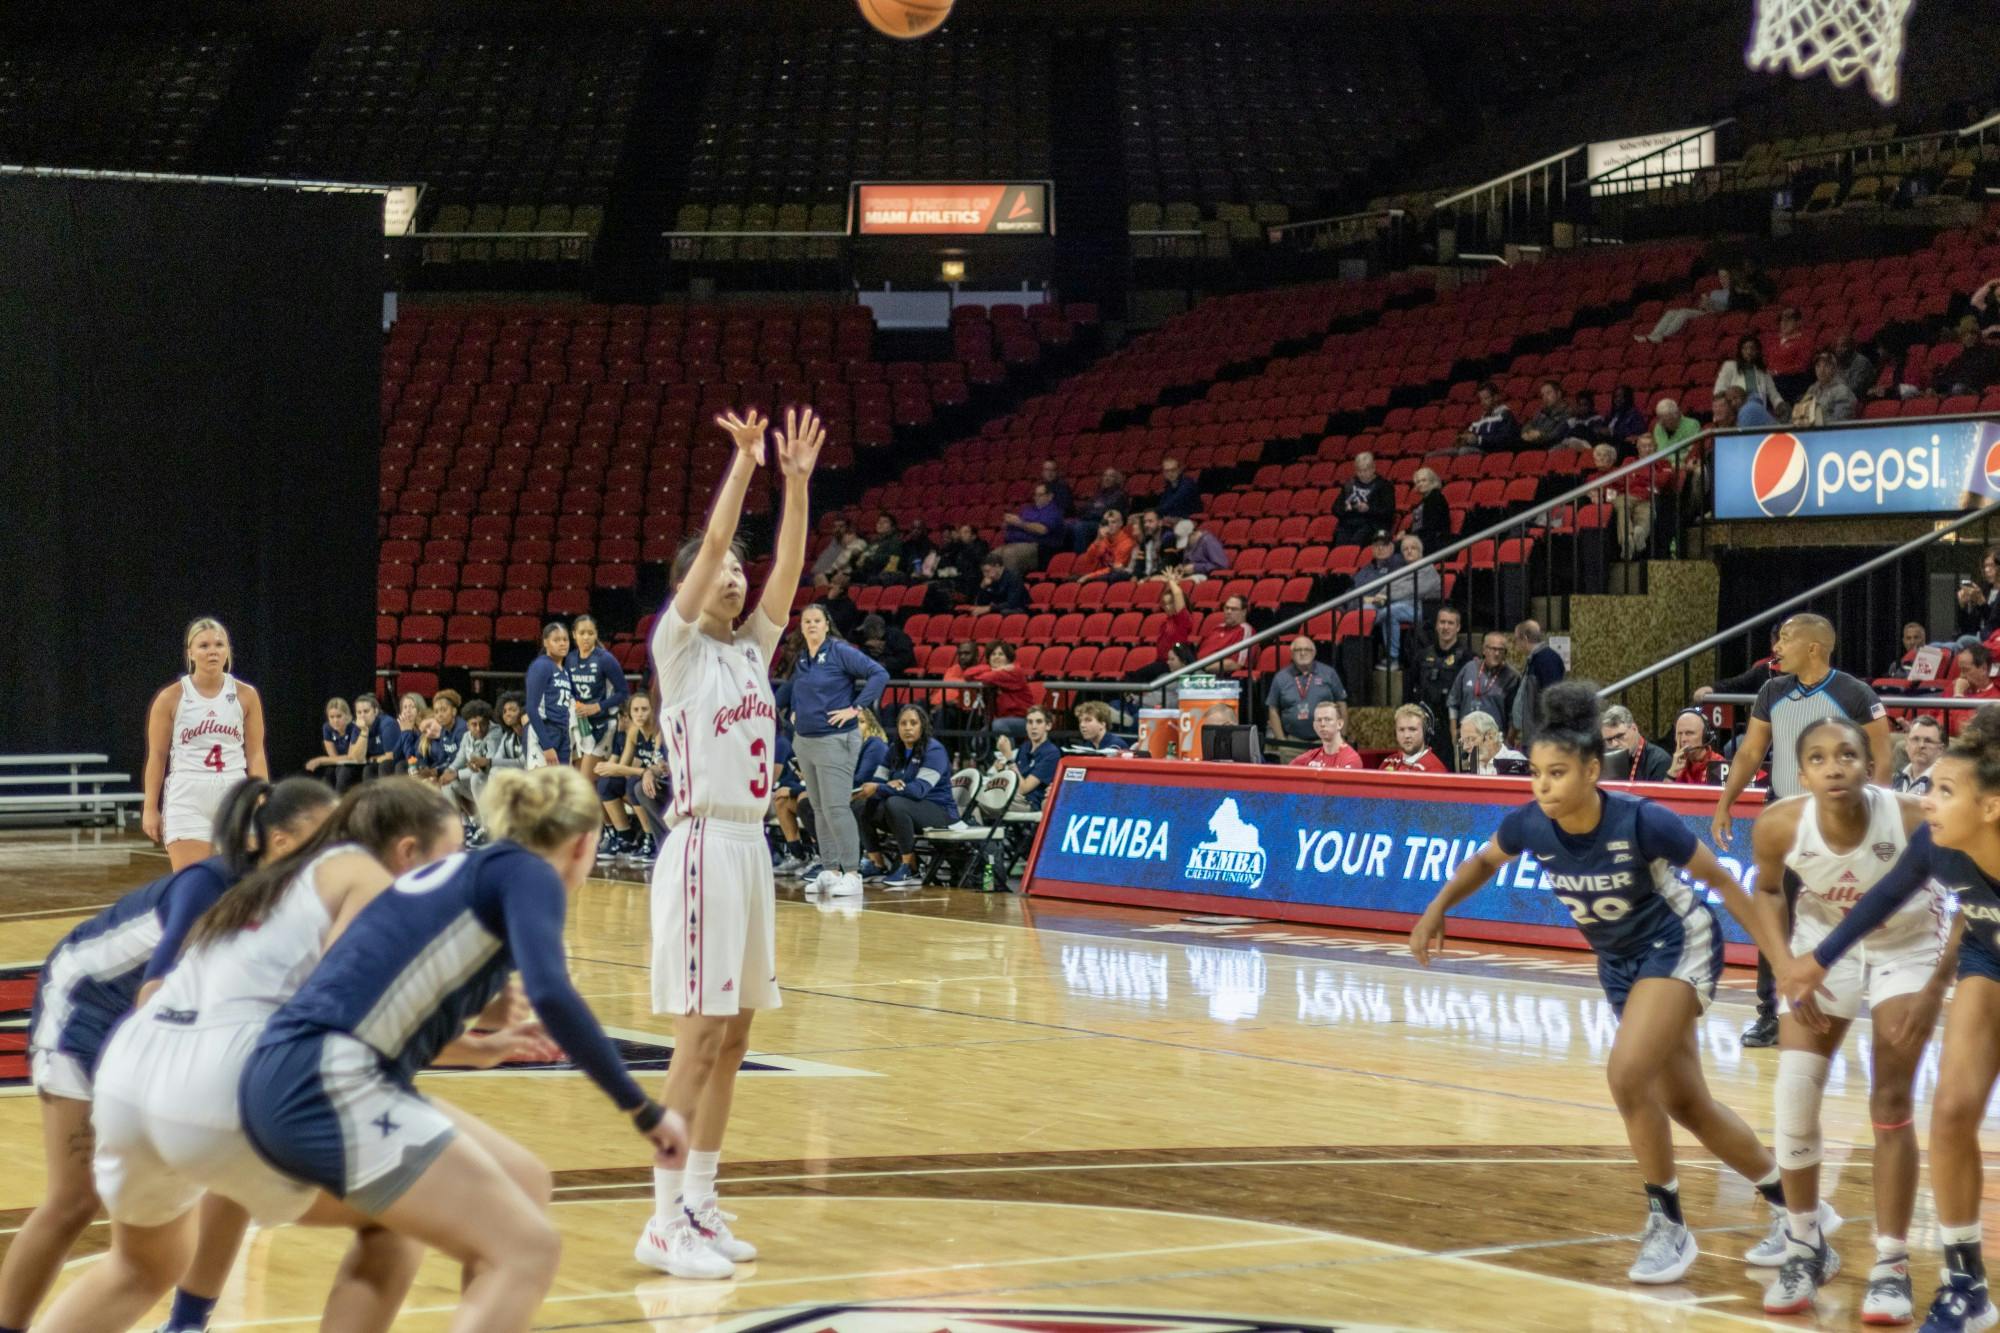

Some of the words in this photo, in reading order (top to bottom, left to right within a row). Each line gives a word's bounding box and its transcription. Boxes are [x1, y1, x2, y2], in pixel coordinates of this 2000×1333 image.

[865, 210, 908, 225] MIAMI
[909, 210, 981, 225] ATHLETICS
[1052, 692, 1060, 709] 7
[1180, 711, 1191, 732] G
[1712, 706, 1723, 727] 6
[203, 744, 225, 773] 4
[750, 738, 769, 798] 3
[1061, 814, 1169, 862] KEMBA
[1186, 847, 1262, 874] KEMBA
[1295, 828, 1393, 878] YOUR
[1184, 868, 1222, 881] CREDIT
[1222, 871, 1257, 884] UNION
[1557, 896, 1631, 925] 20
